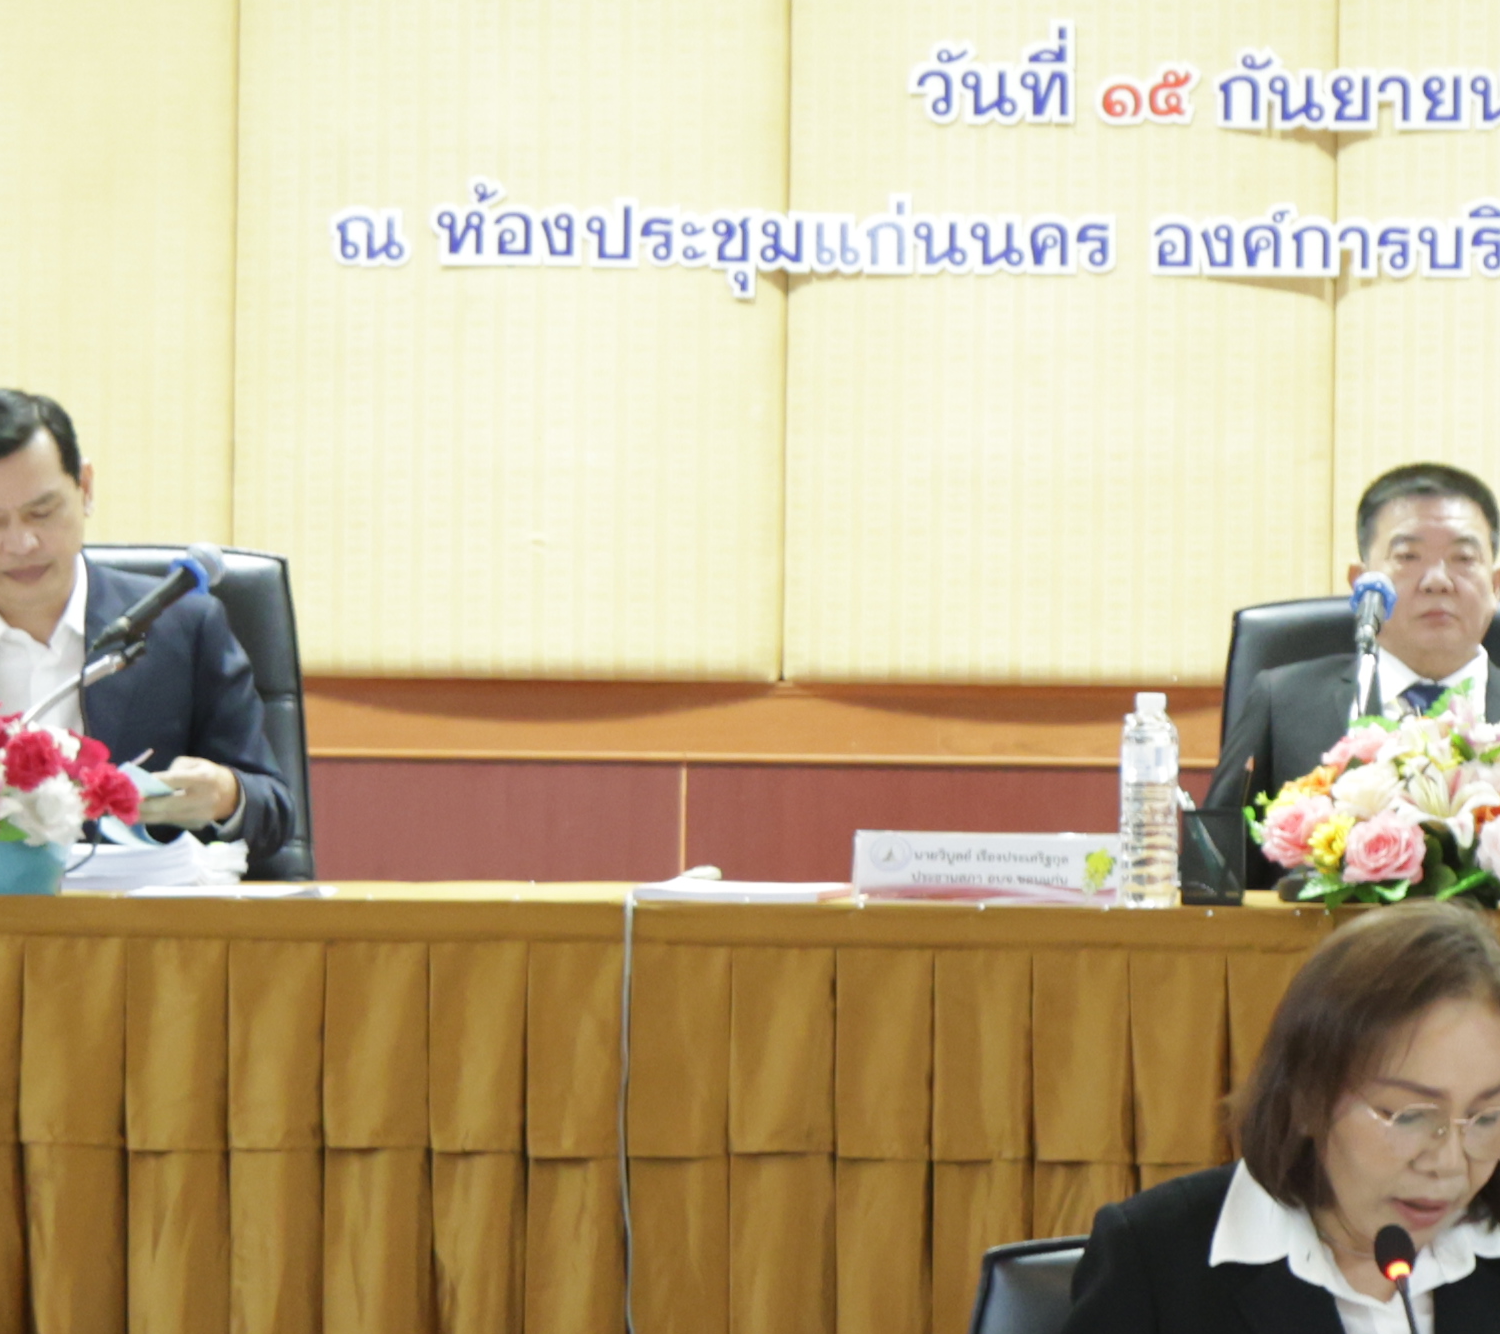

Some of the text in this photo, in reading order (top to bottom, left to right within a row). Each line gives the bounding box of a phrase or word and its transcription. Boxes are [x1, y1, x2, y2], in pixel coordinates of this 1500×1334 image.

[916, 27, 1071, 119] วันที่
[1102, 74, 1192, 119] ๑๕
[335, 214, 406, 263] ณ
[436, 184, 1112, 293] ห้องประชุมแก่นนคร
